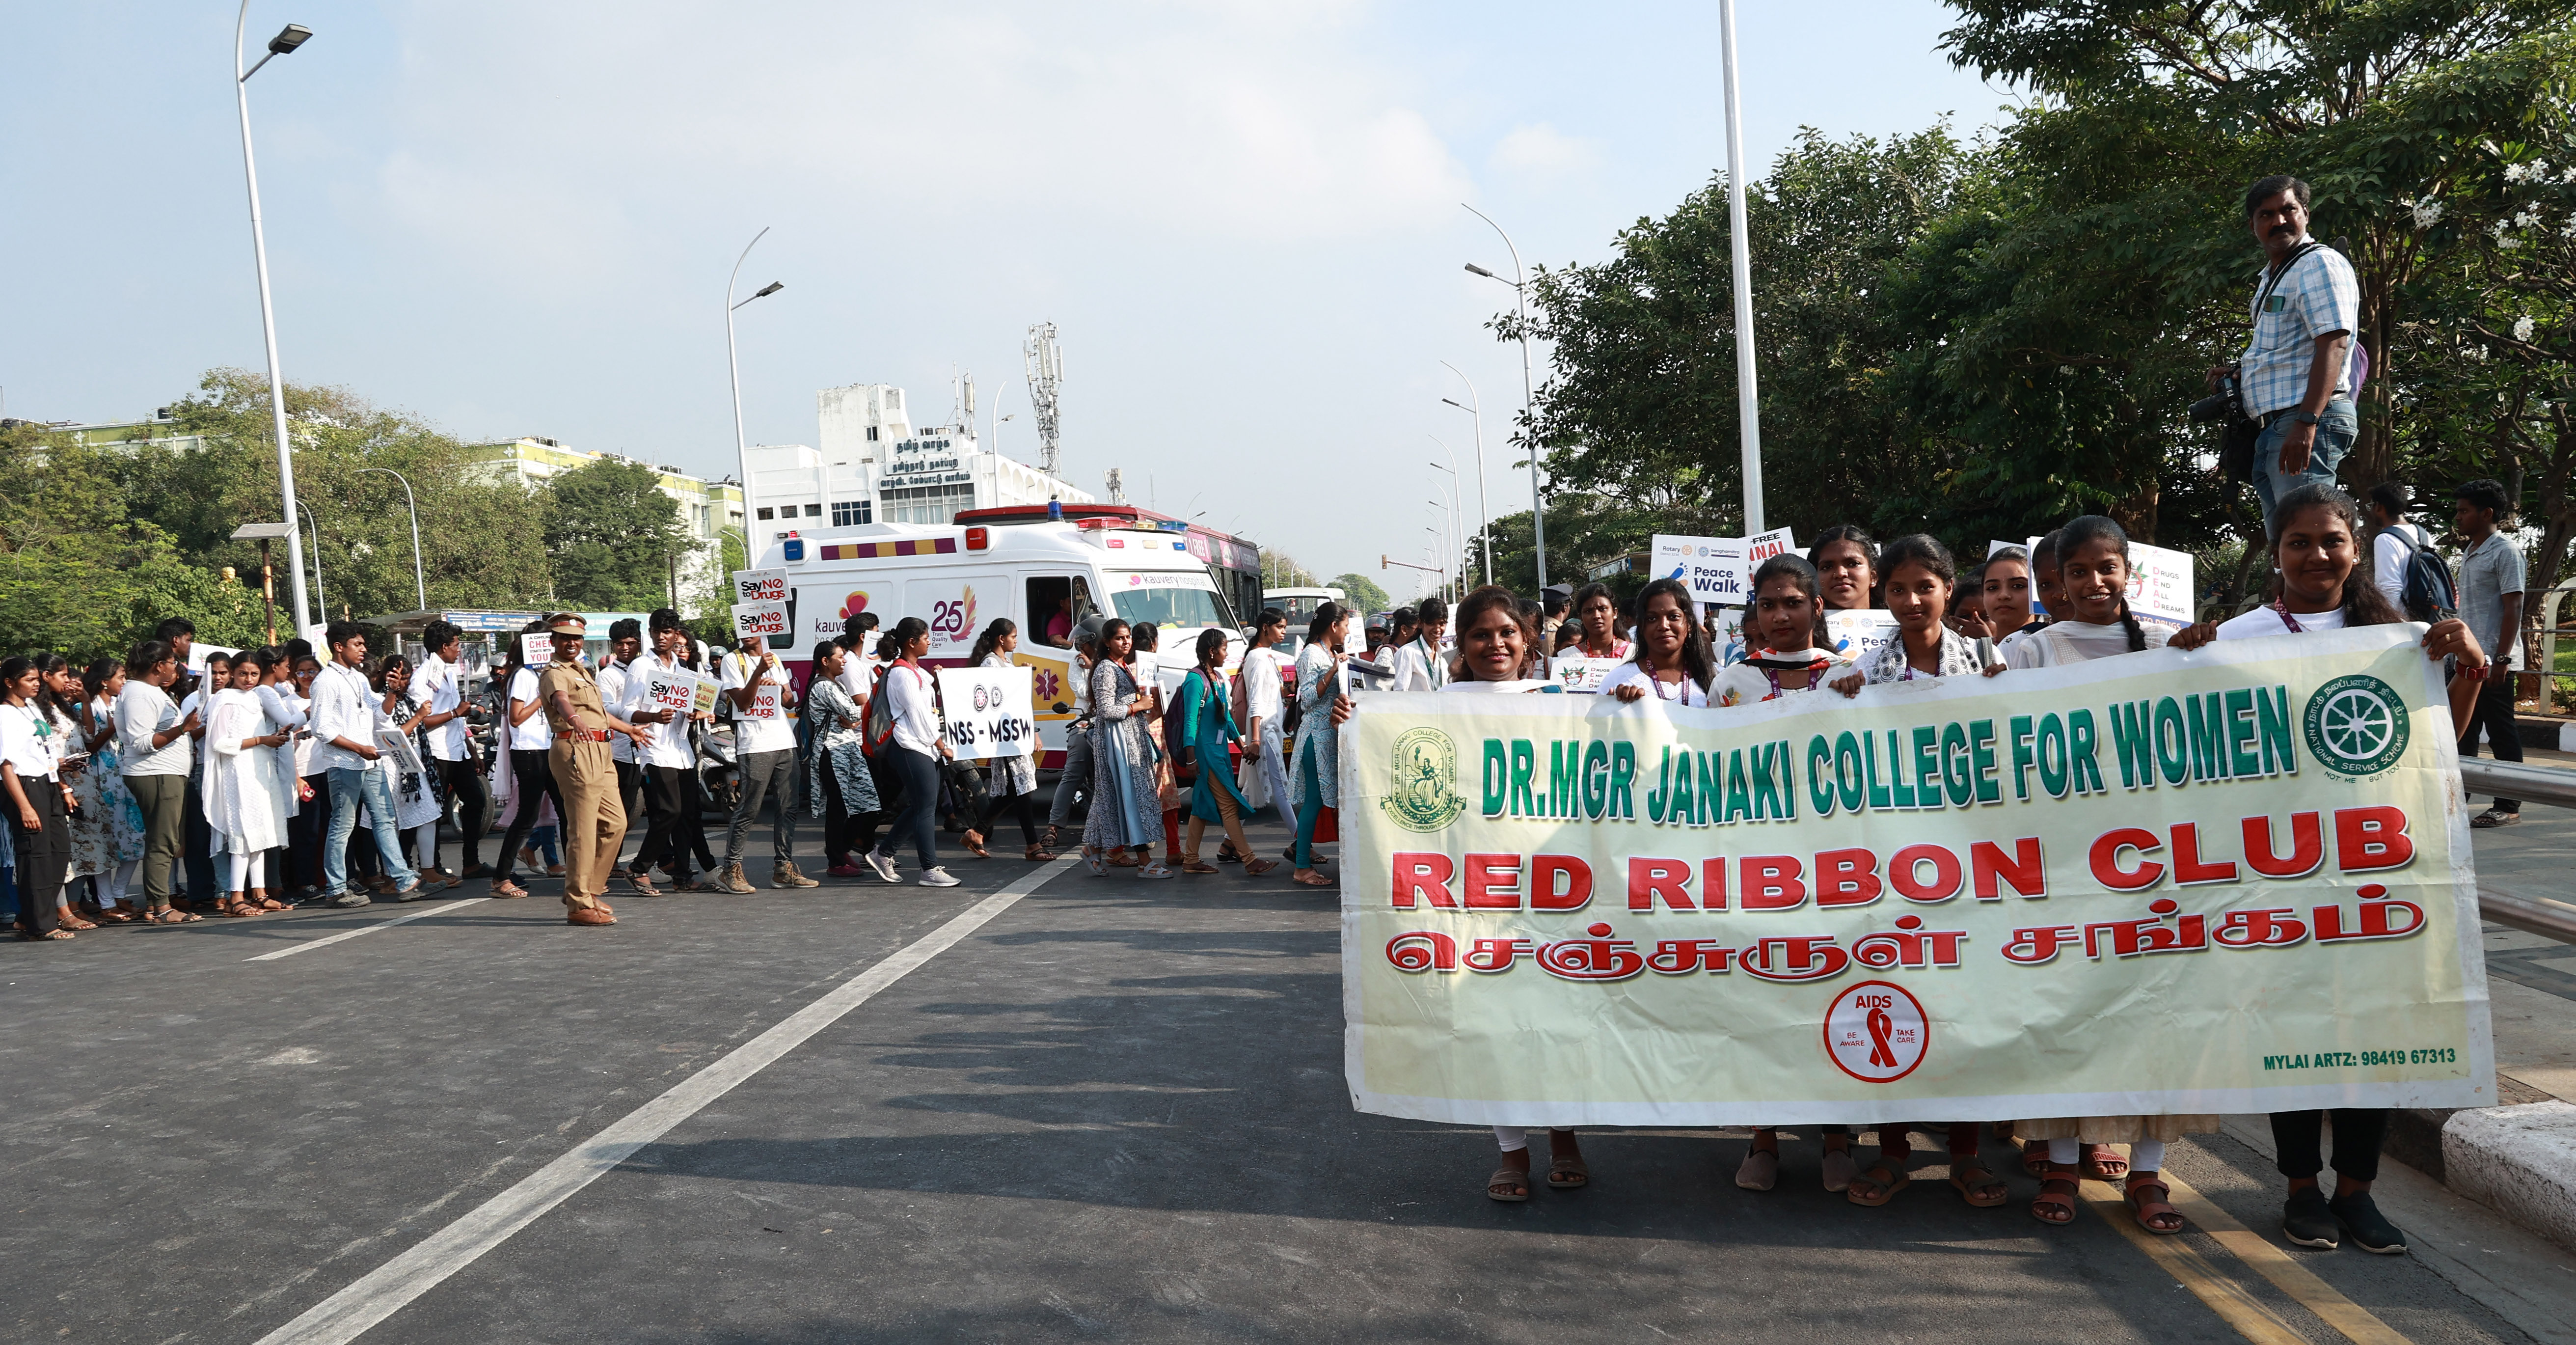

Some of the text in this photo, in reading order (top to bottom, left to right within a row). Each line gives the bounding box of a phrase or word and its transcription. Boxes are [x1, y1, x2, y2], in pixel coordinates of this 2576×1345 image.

[897, 437, 950, 454] தமிழ் வாழ்க
[893, 460, 925, 473] தமிழ்நாடு
[880, 477, 907, 488] வாழ்விட
[1193, 538, 1205, 557] FREE
[1694, 567, 1734, 578] Peace
[2153, 567, 2179, 579] DRUGS
[741, 578, 783, 592] Say NO
[1142, 574, 1206, 587] kauvery hospital
[1694, 577, 1741, 593] Walk
[2153, 578, 2170, 588] END
[751, 590, 786, 600] Drugs
[2153, 590, 2169, 600] ALL
[2154, 600, 2185, 614] DREAMS
[740, 612, 782, 625] Say NO
[931, 601, 963, 632] 25
[749, 623, 784, 633] Drugs
[815, 618, 846, 632] kauve
[1861, 637, 1888, 646] Pea
[651, 681, 671, 695] Say
[670, 685, 689, 697] NO
[656, 692, 688, 709] Drugs
[756, 696, 774, 706] NO
[744, 708, 774, 718] Drugs
[948, 721, 975, 745] NSS
[988, 718, 1030, 742] MSSW
[1396, 733, 1410, 751] JANAKI
[1413, 730, 1442, 741] COLLEGE
[1442, 739, 1452, 752] FOR
[1482, 685, 2297, 825] DR.MGR JANAKI COLLEGE FOR WOMEN
[2308, 729, 2404, 772] NATIONAL SERVICE SCHEME
[391, 750, 406, 770] Walk
[2324, 771, 2341, 782] NOT
[2369, 773, 2384, 782] BUT
[2386, 764, 2400, 775] YOU
[1387, 806, 1413, 828] EXCELLENCE
[1437, 808, 1457, 827] DILIGENCE
[1391, 805, 2415, 912] RED RIBBON CLUB
[1384, 883, 2428, 981] செஞ்சுருள் சங்கம்
[1855, 995, 1892, 1009] AIDS
[2264, 1048, 2456, 1071] MYLAI ARTZ: 98419 67313
